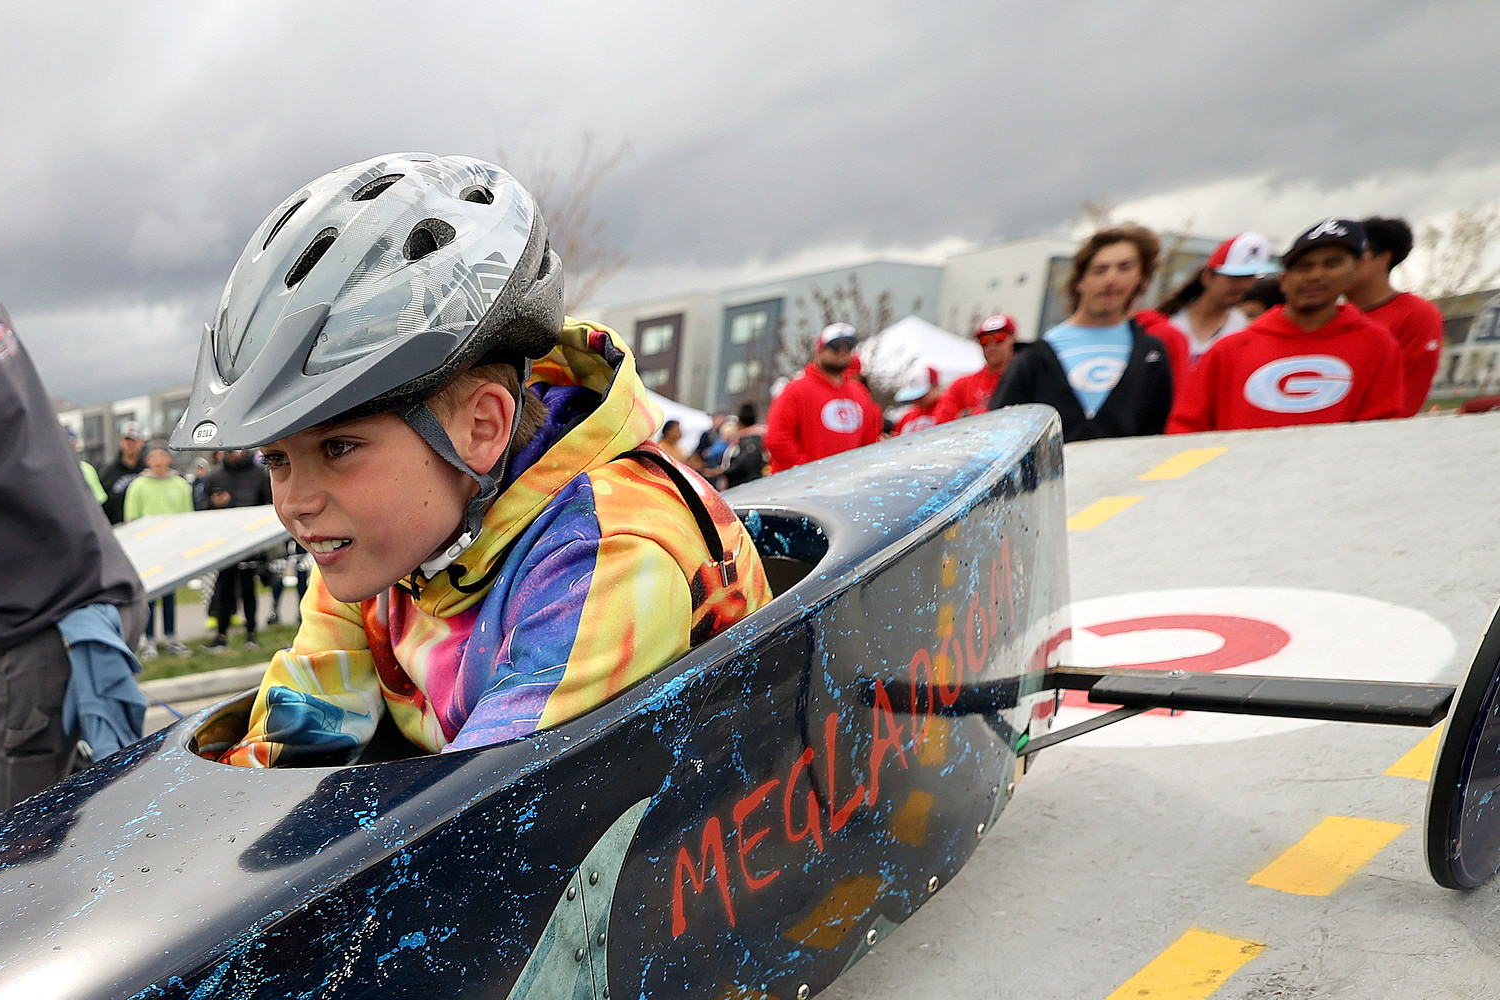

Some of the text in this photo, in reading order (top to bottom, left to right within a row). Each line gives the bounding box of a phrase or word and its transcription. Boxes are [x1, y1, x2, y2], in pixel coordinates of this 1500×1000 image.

[1243, 354, 1354, 414] G
[197, 429, 213, 438] BELL
[672, 538, 1017, 938] MEGLADOOM
